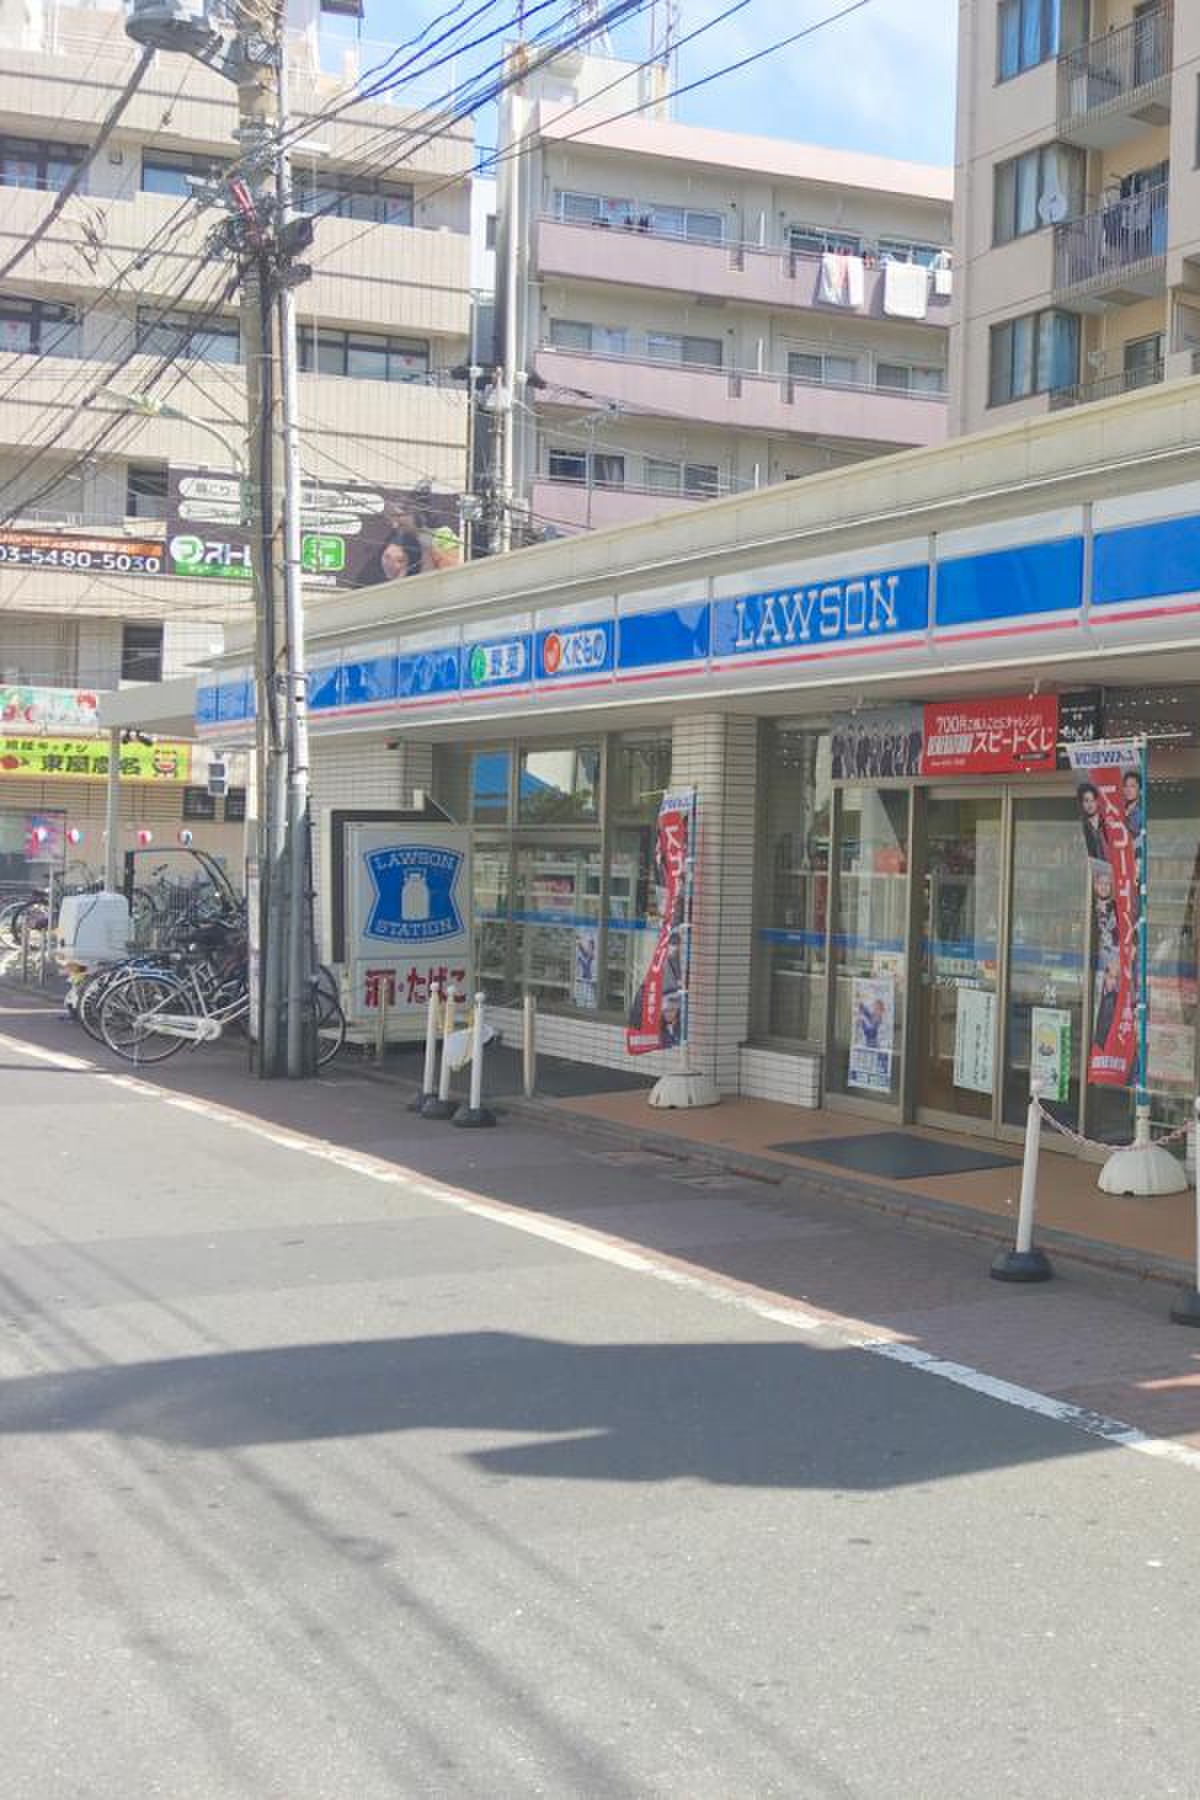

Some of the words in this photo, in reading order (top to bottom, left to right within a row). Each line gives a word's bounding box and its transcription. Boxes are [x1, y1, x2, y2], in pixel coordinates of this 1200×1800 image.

[735, 576, 899, 647] LAWSON
[972, 726, 1054, 755] スピードくじ
[373, 851, 456, 870] LAWSON
[377, 917, 454, 938] STATION
